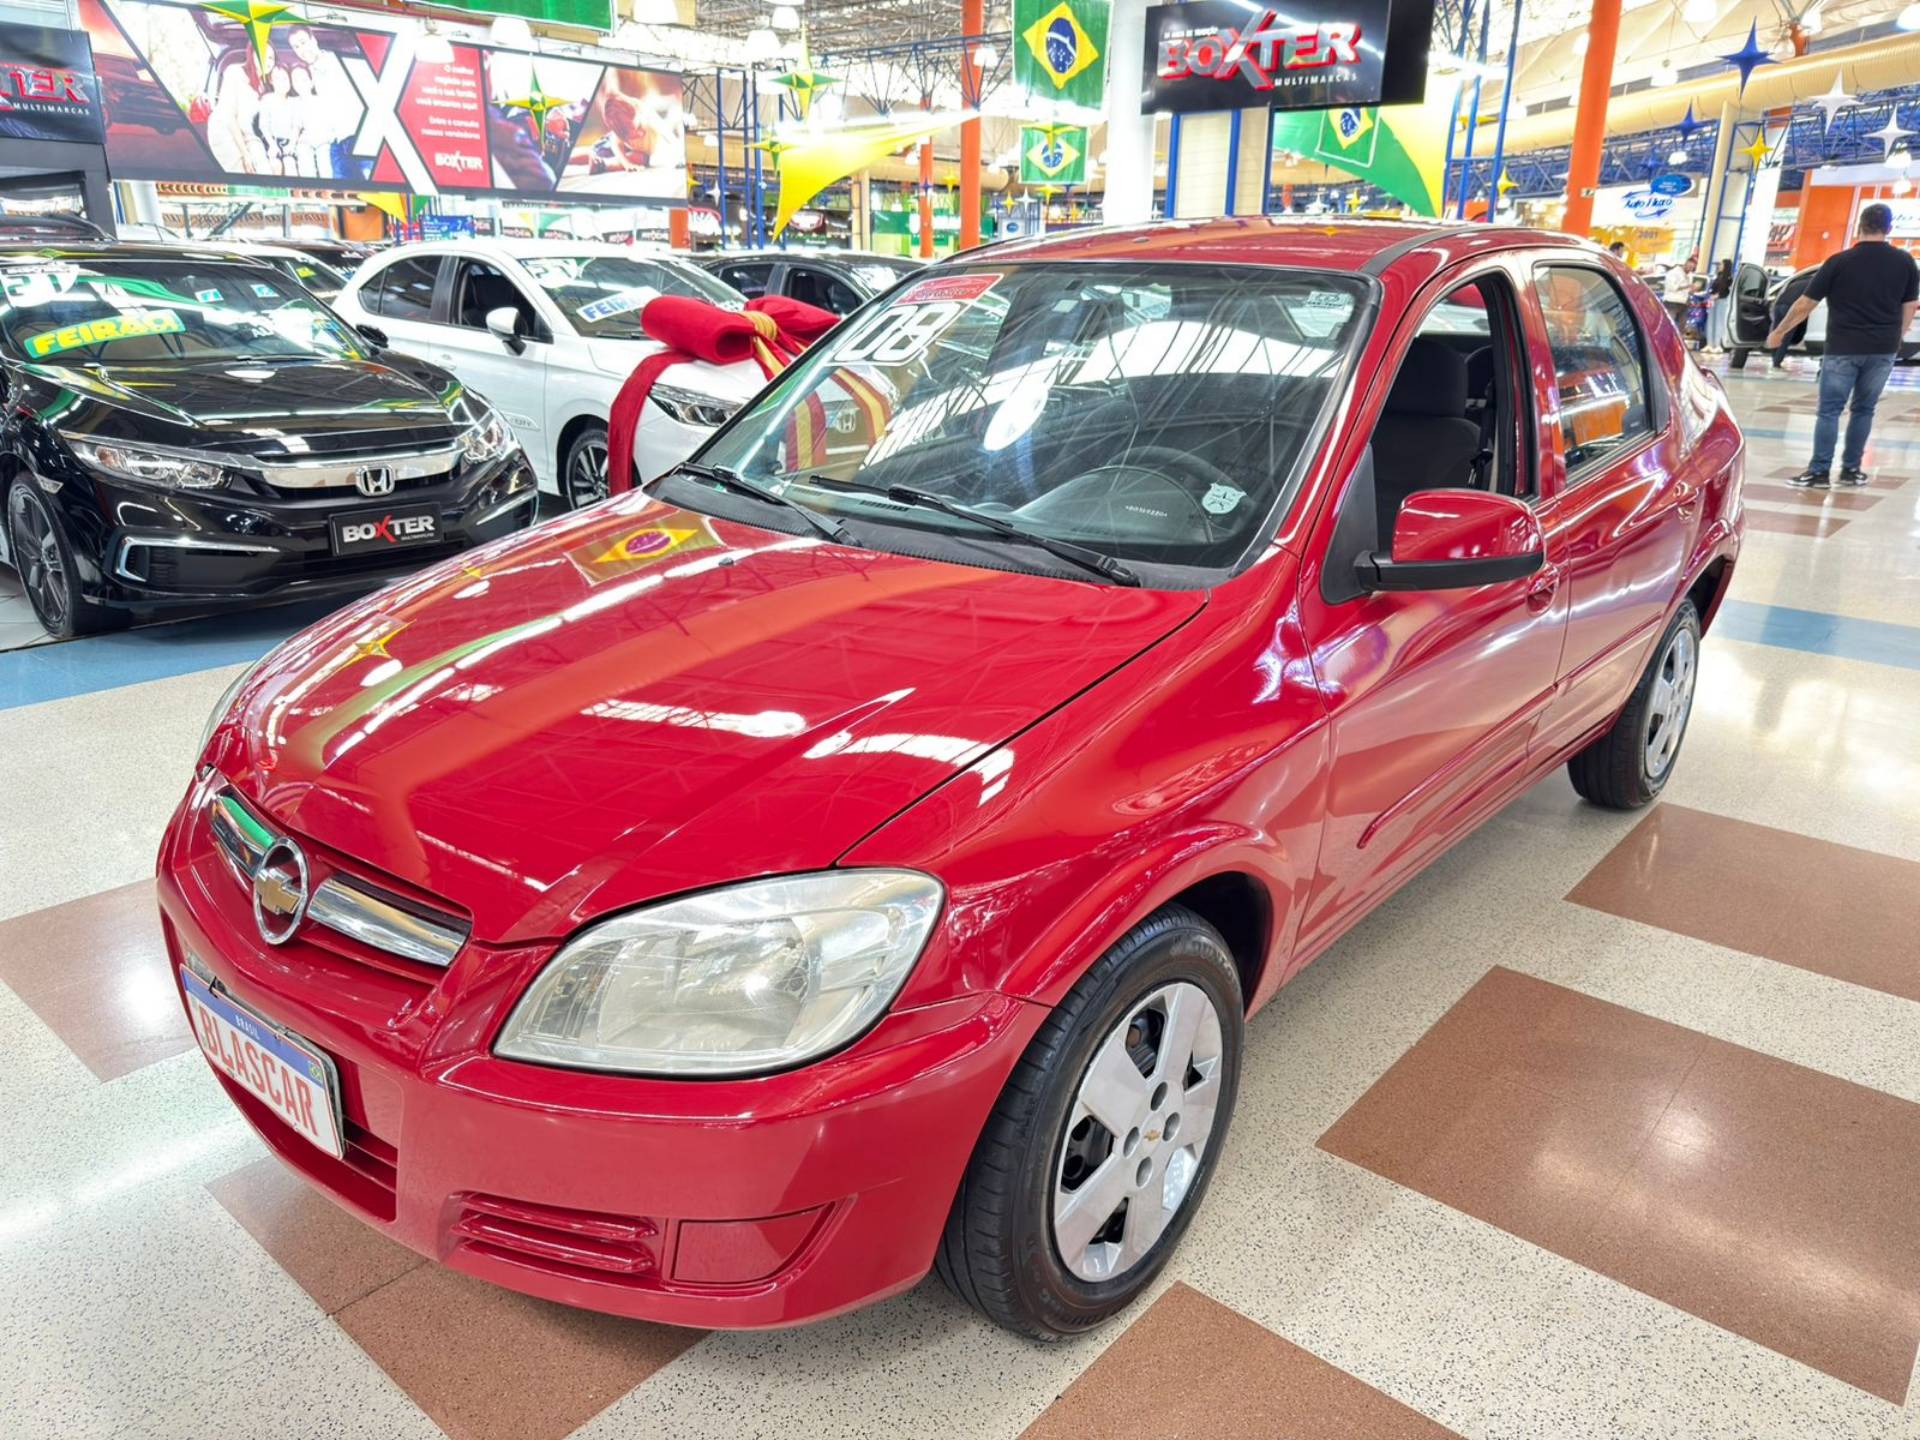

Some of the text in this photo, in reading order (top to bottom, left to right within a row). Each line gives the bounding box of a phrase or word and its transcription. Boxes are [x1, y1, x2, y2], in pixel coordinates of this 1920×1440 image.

[1157, 8, 1361, 91] BOXTER
[1273, 74, 1358, 88] MULTIMARCAS
[12, 102, 91, 116] MULTIMARCAS
[434, 150, 484, 173] BOXTER
[833, 301, 962, 361] 08
[342, 512, 435, 544] BOXTER
[199, 1004, 319, 1137] BLASCAR
